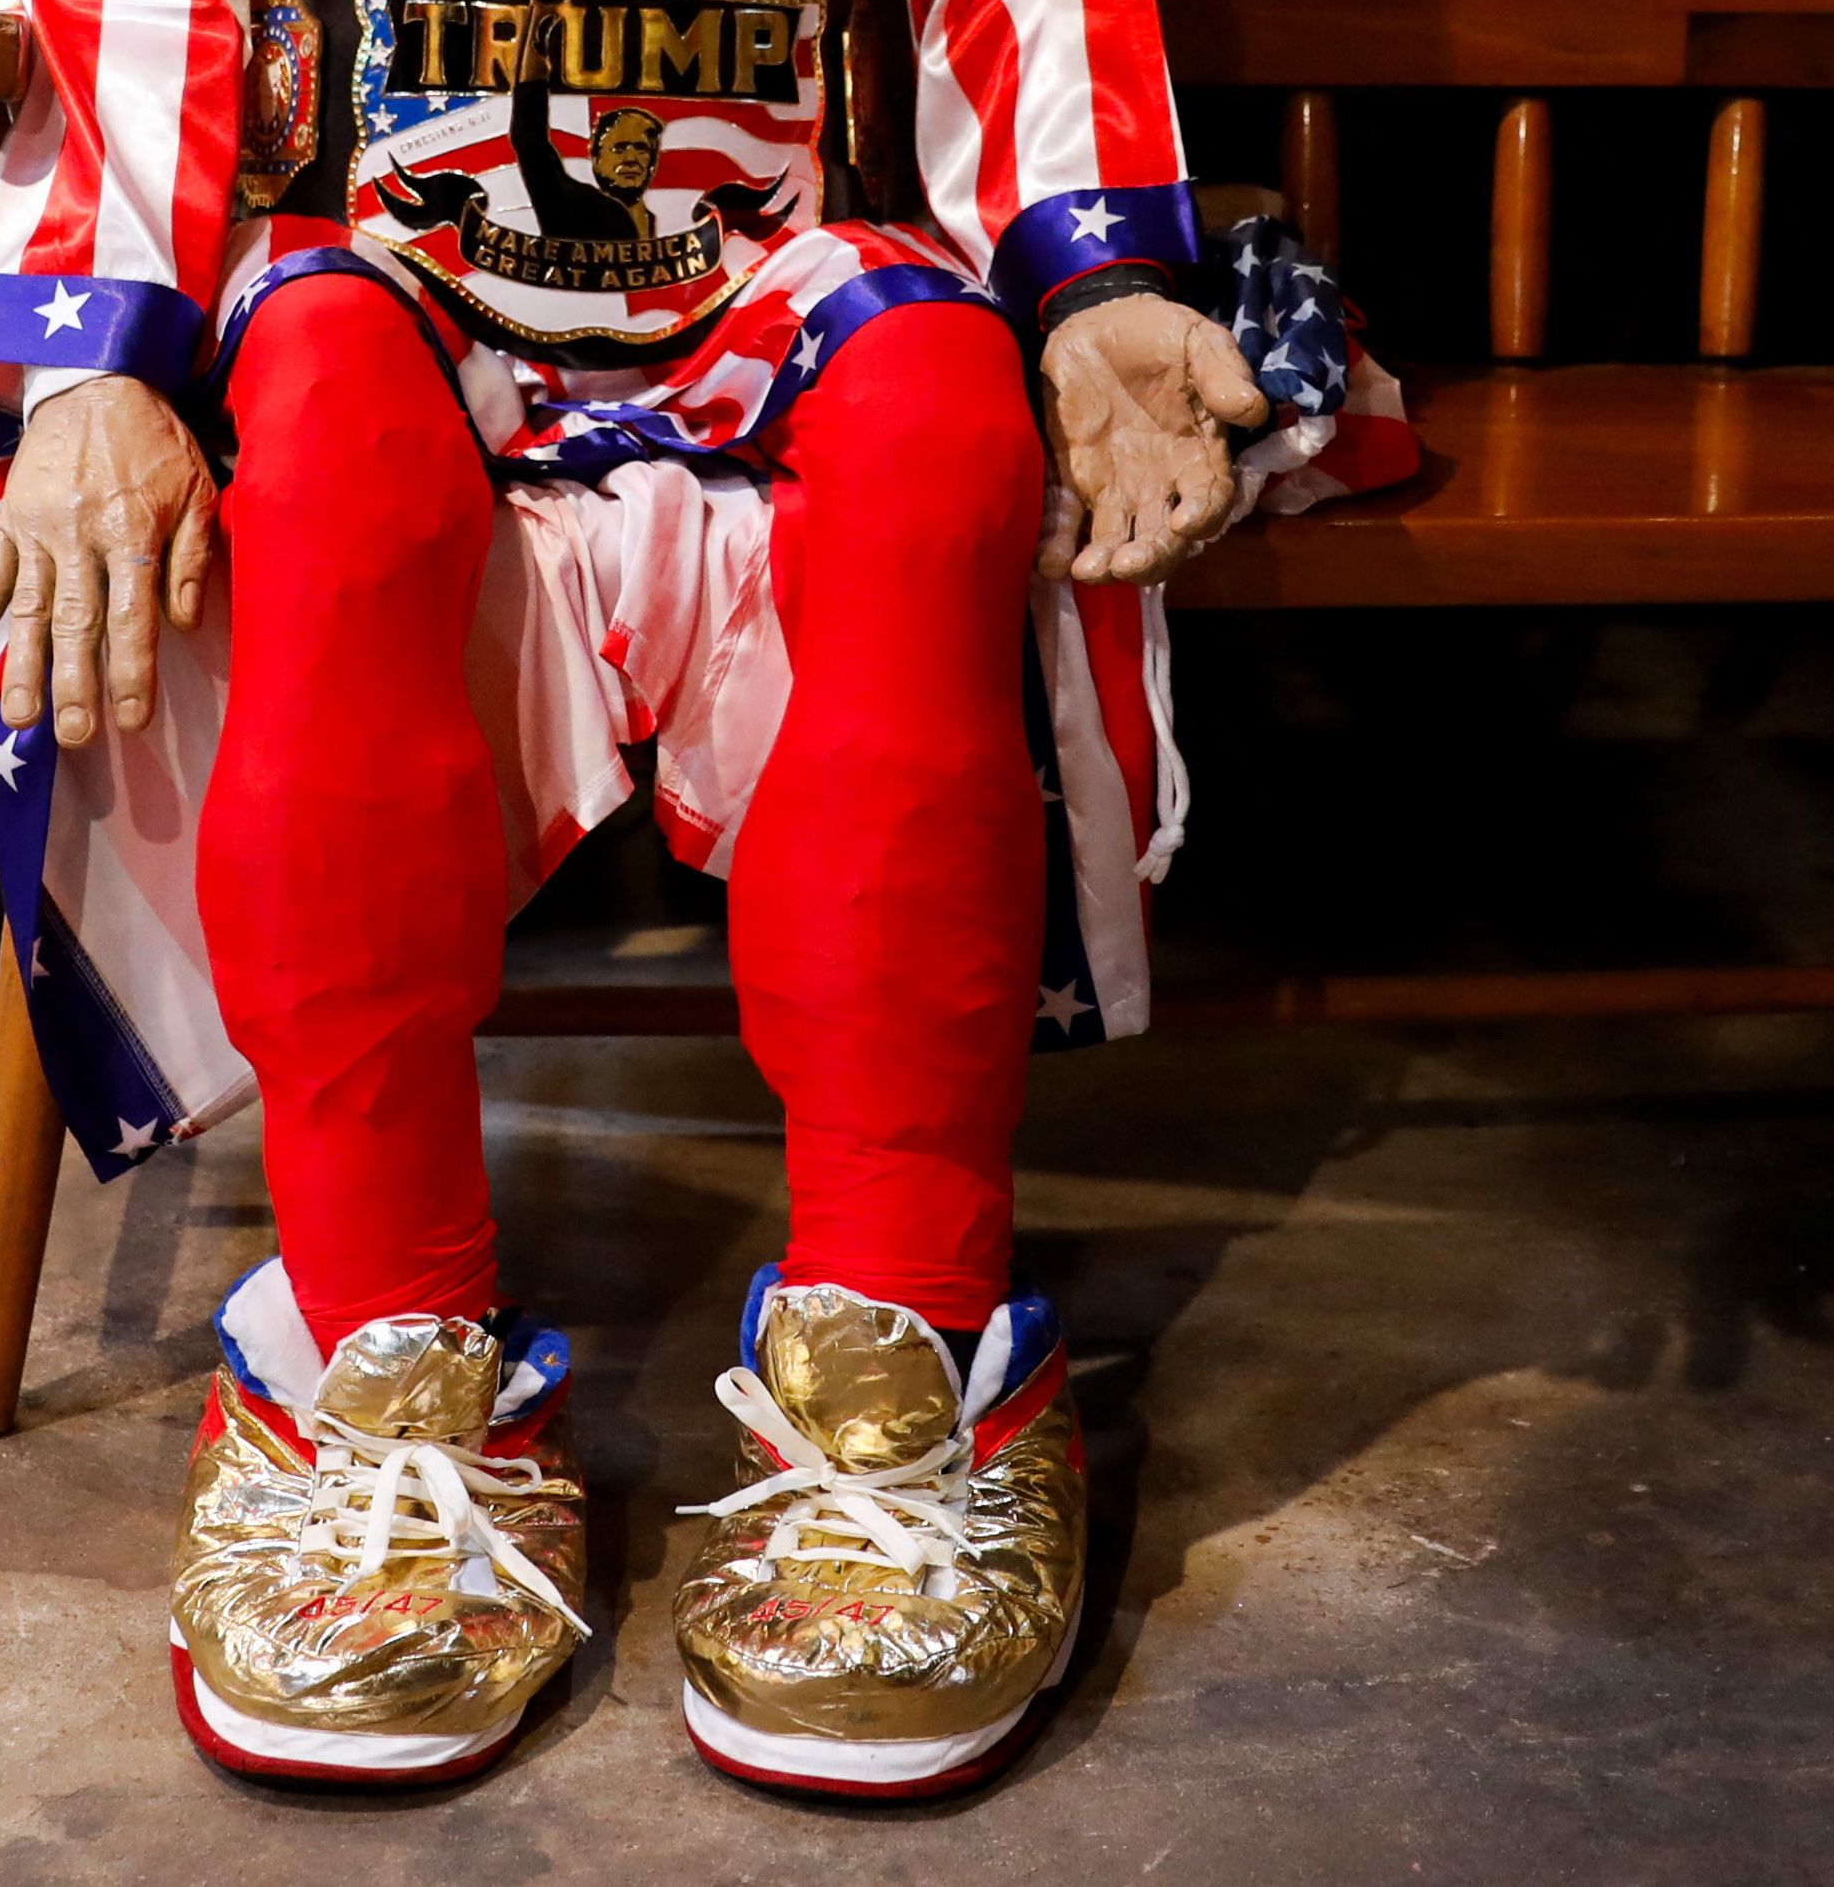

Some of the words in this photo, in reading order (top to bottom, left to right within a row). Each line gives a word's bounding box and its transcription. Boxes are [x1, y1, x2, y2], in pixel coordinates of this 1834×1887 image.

[403, 0, 791, 94] TRUMP
[474, 218, 561, 261] MAKE
[570, 232, 704, 264] AMERICA
[473, 244, 587, 288] GREAT
[599, 252, 710, 289] AGAIN
[296, 1588, 445, 1620] 45/47
[746, 1595, 897, 1627] 45/47
